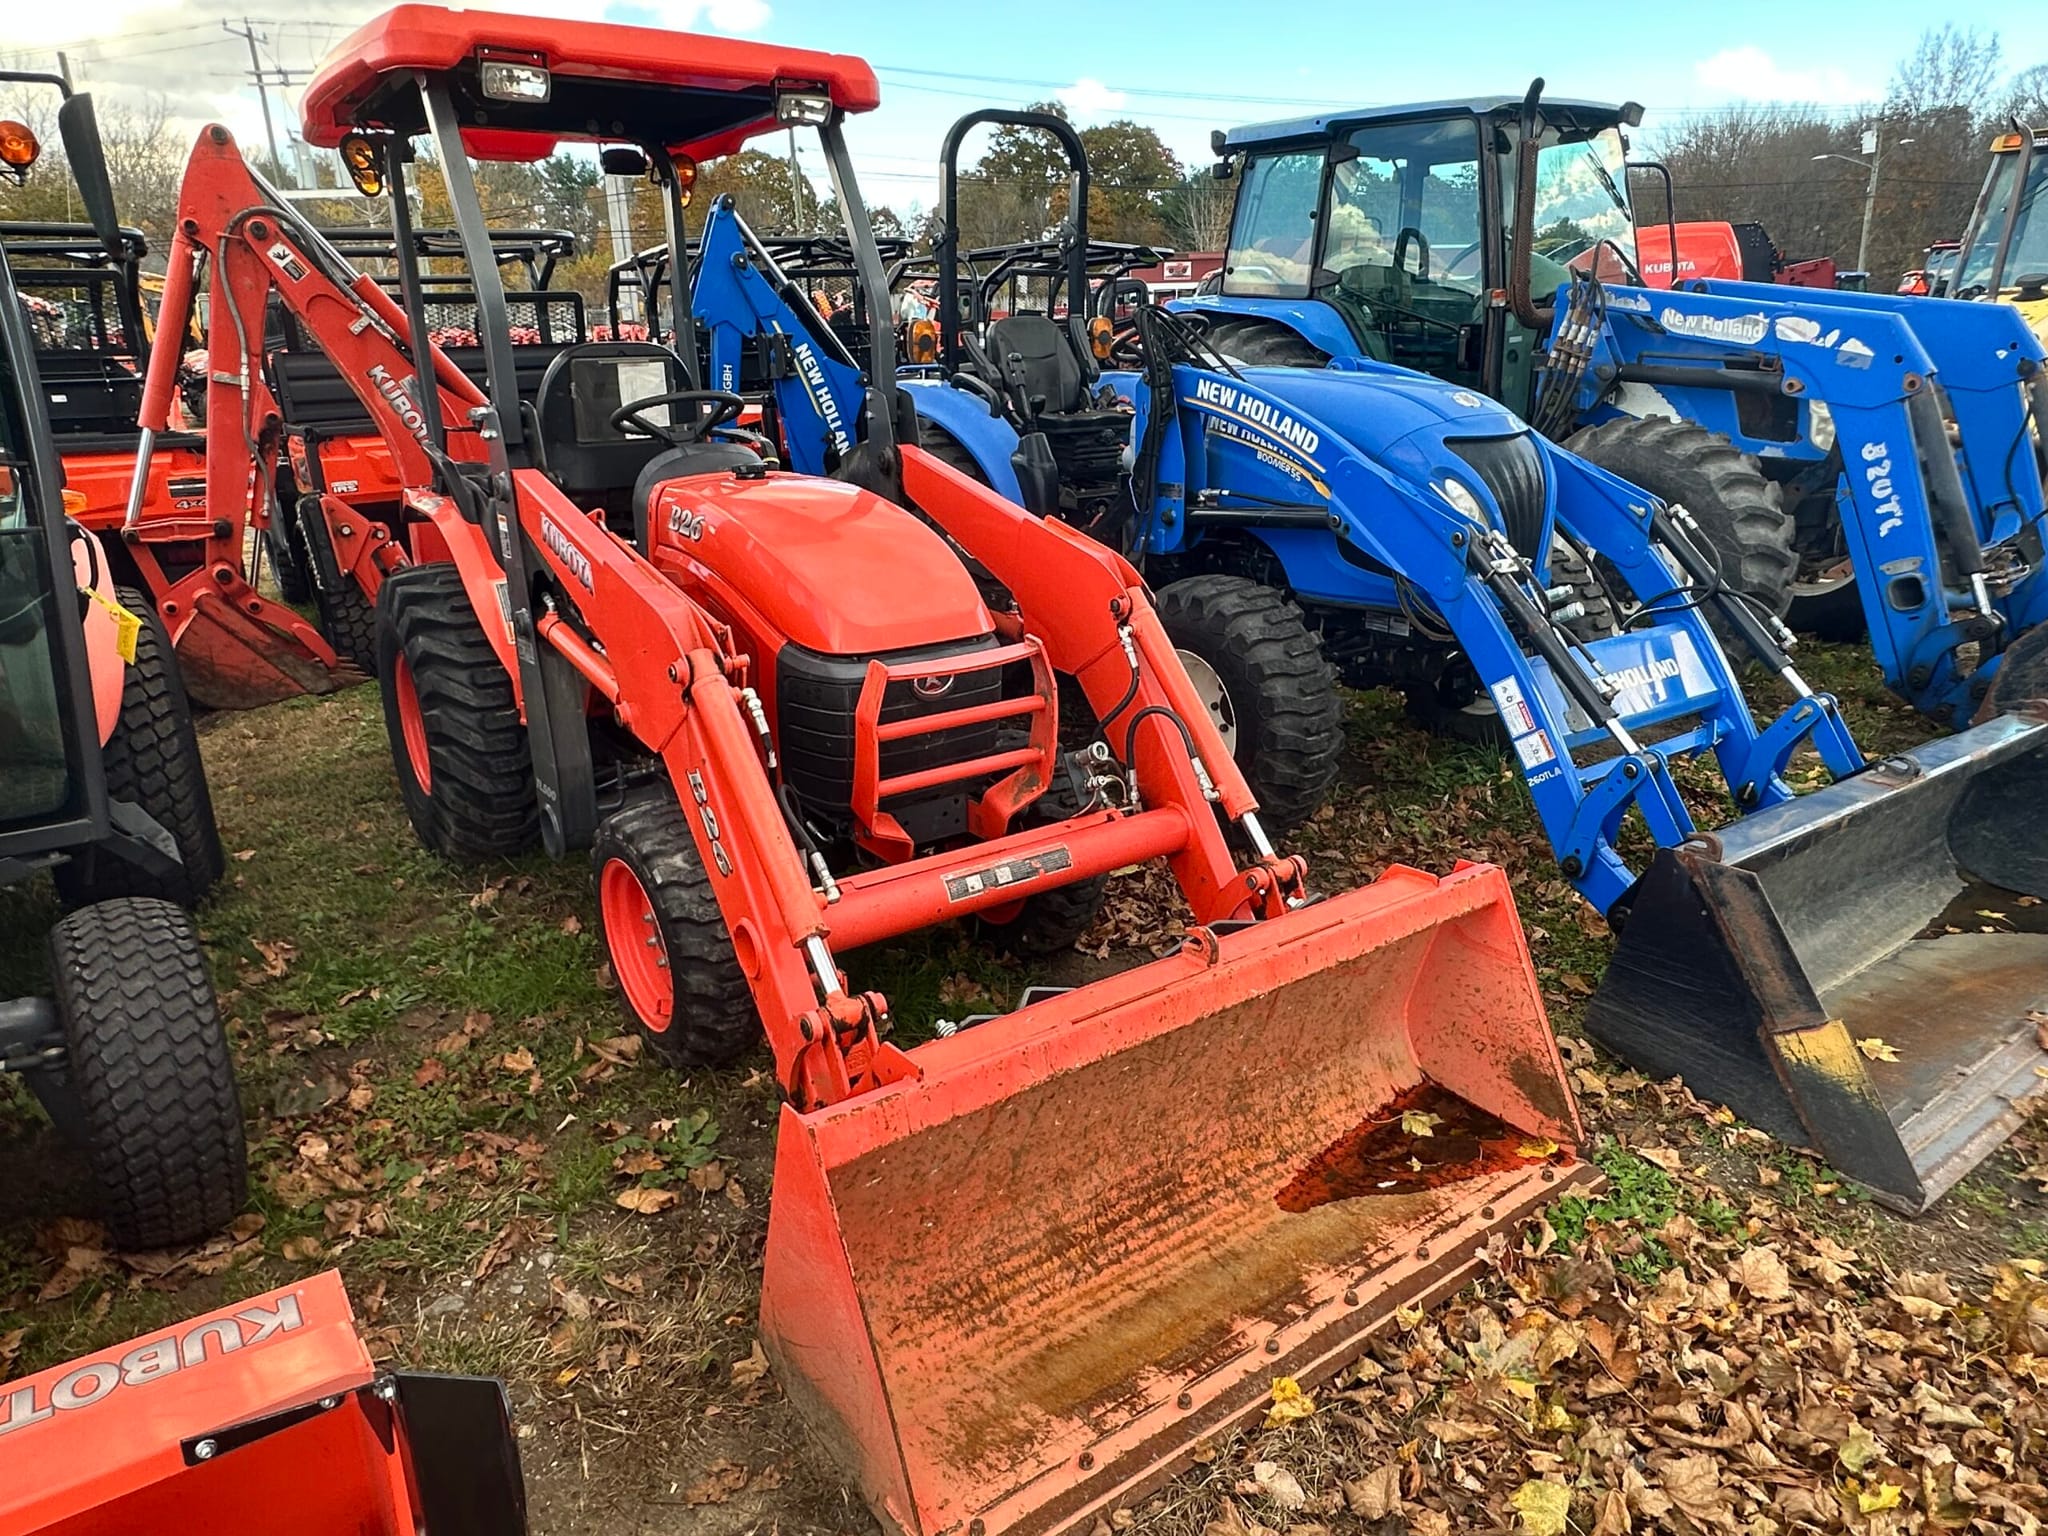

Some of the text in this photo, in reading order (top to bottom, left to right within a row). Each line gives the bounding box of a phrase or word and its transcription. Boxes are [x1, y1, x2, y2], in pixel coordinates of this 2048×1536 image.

[1664, 308, 1765, 338] New Holland
[368, 364, 430, 445] KUBOT
[722, 364, 733, 393] GBH
[795, 343, 852, 457] NEW HOLLAN
[1197, 378, 1237, 409] NEW
[1237, 393, 1319, 454] HOLLAND
[541, 515, 594, 596] KUBOTA
[668, 505, 704, 541] B26
[686, 768, 733, 877] B26
[0, 1294, 304, 1436] KUBOT
